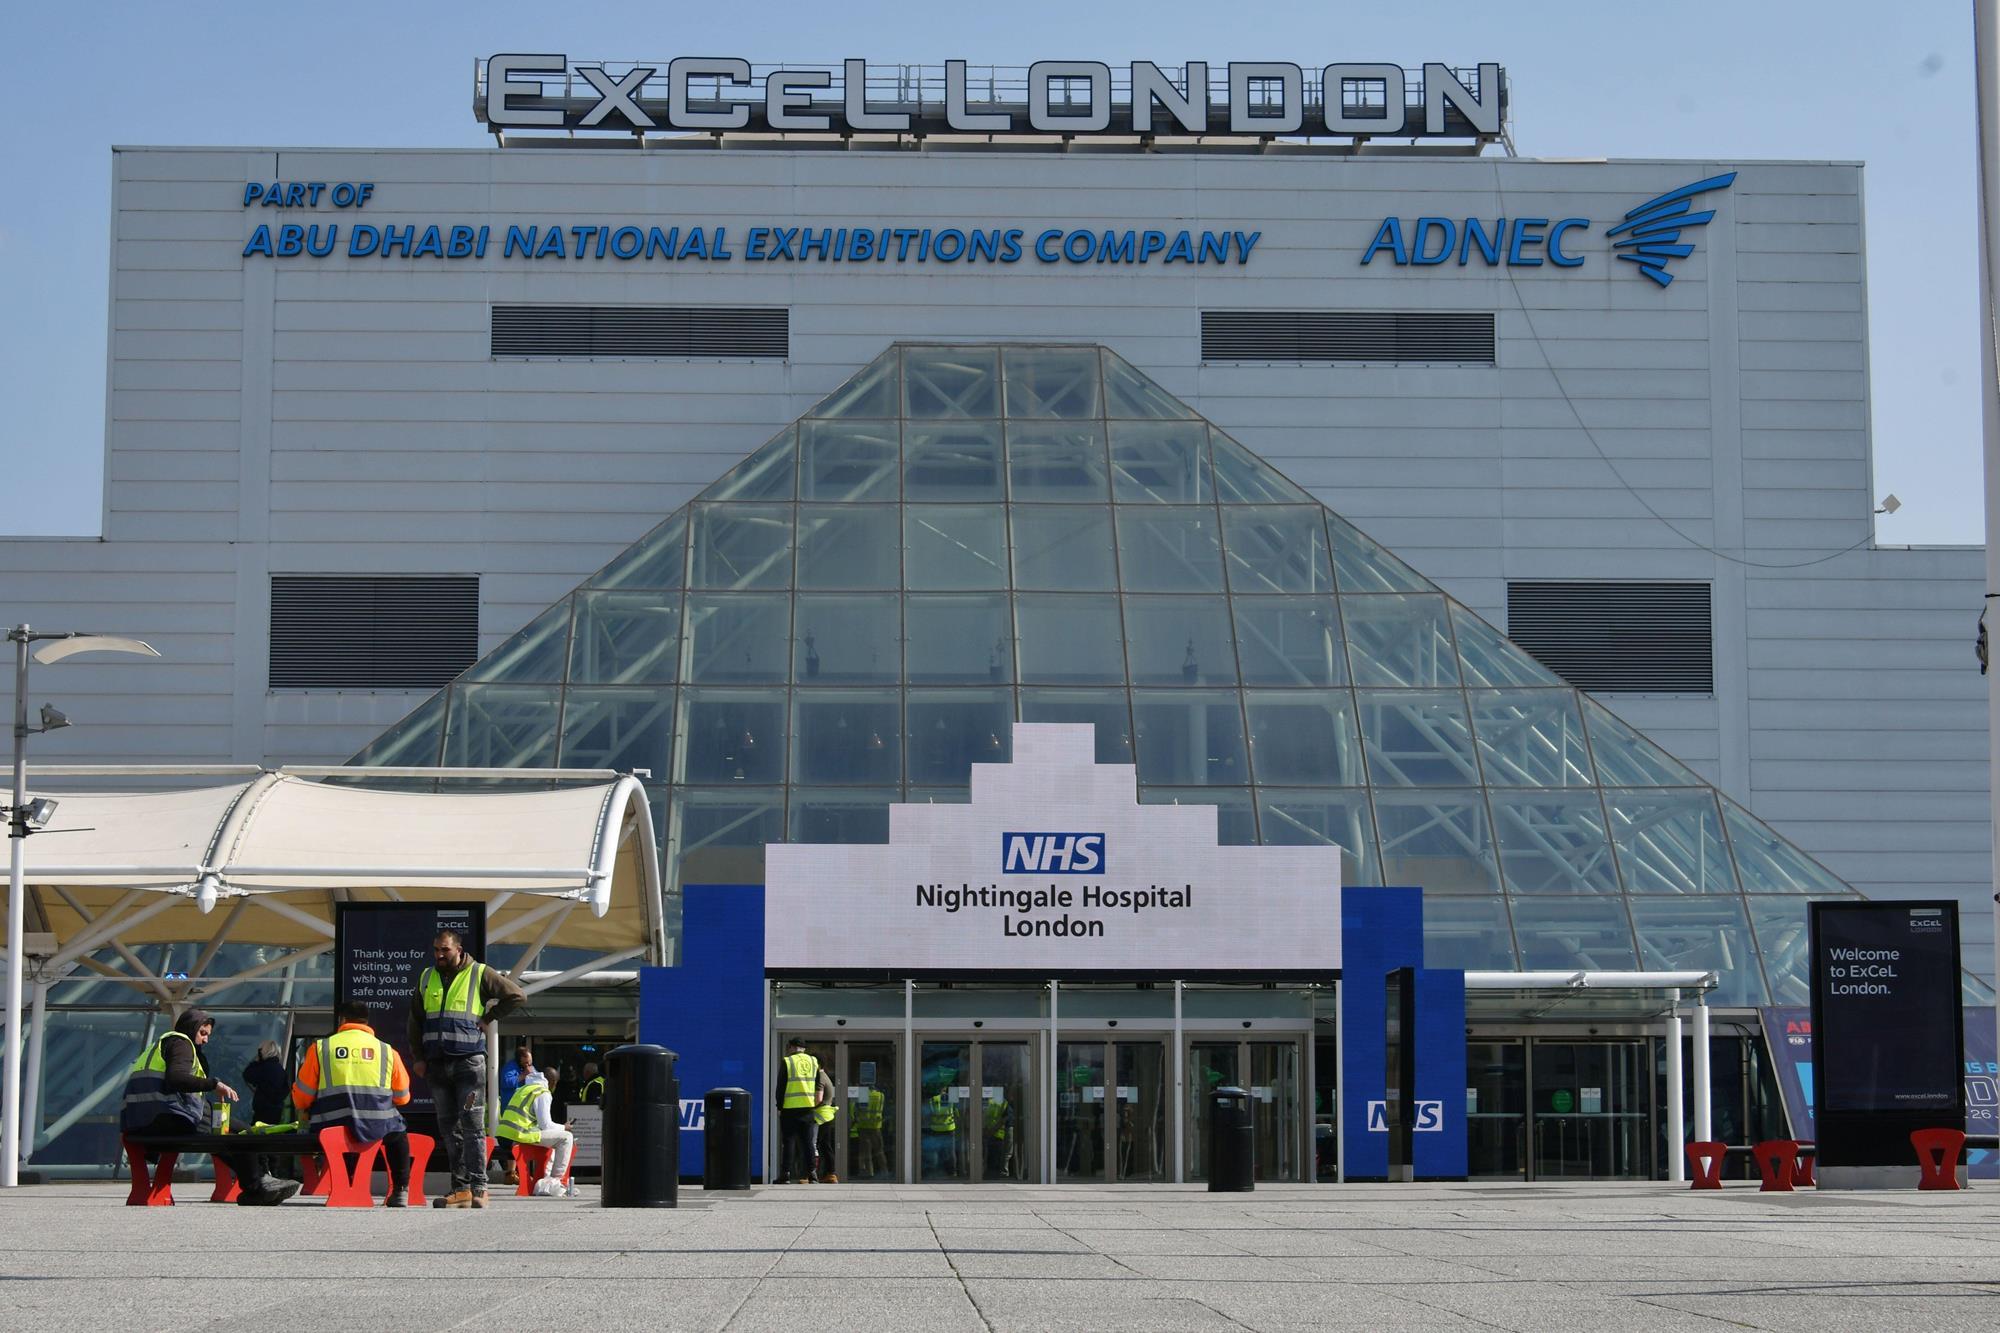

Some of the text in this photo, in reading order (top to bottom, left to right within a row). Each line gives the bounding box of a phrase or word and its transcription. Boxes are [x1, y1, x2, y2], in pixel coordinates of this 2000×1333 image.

[945, 59, 1500, 135] LONDON
[244, 182, 374, 208] PART OF
[243, 224, 1262, 264] ABU DHABI NATIONAL EXHIBITIONS COMPANY
[1360, 216, 1590, 267] ADNEC
[1005, 836, 1101, 871] NHS
[916, 884, 1191, 913] Nightingale Hospital
[1003, 914, 1104, 937] London
[352, 949, 425, 960] Thank you for
[1830, 948, 1899, 960] Welcome
[352, 962, 393, 973] visiting,
[1830, 965, 1898, 977] to ExCeL
[352, 974, 408, 985] wish you a
[1831, 982, 1891, 995] London.
[352, 986, 374, 996] safe
[366, 1001, 393, 1010] rney.
[679, 1103, 705, 1127] NH
[1370, 1103, 1439, 1129] NS
[1970, 1110, 1991, 1119] 26
